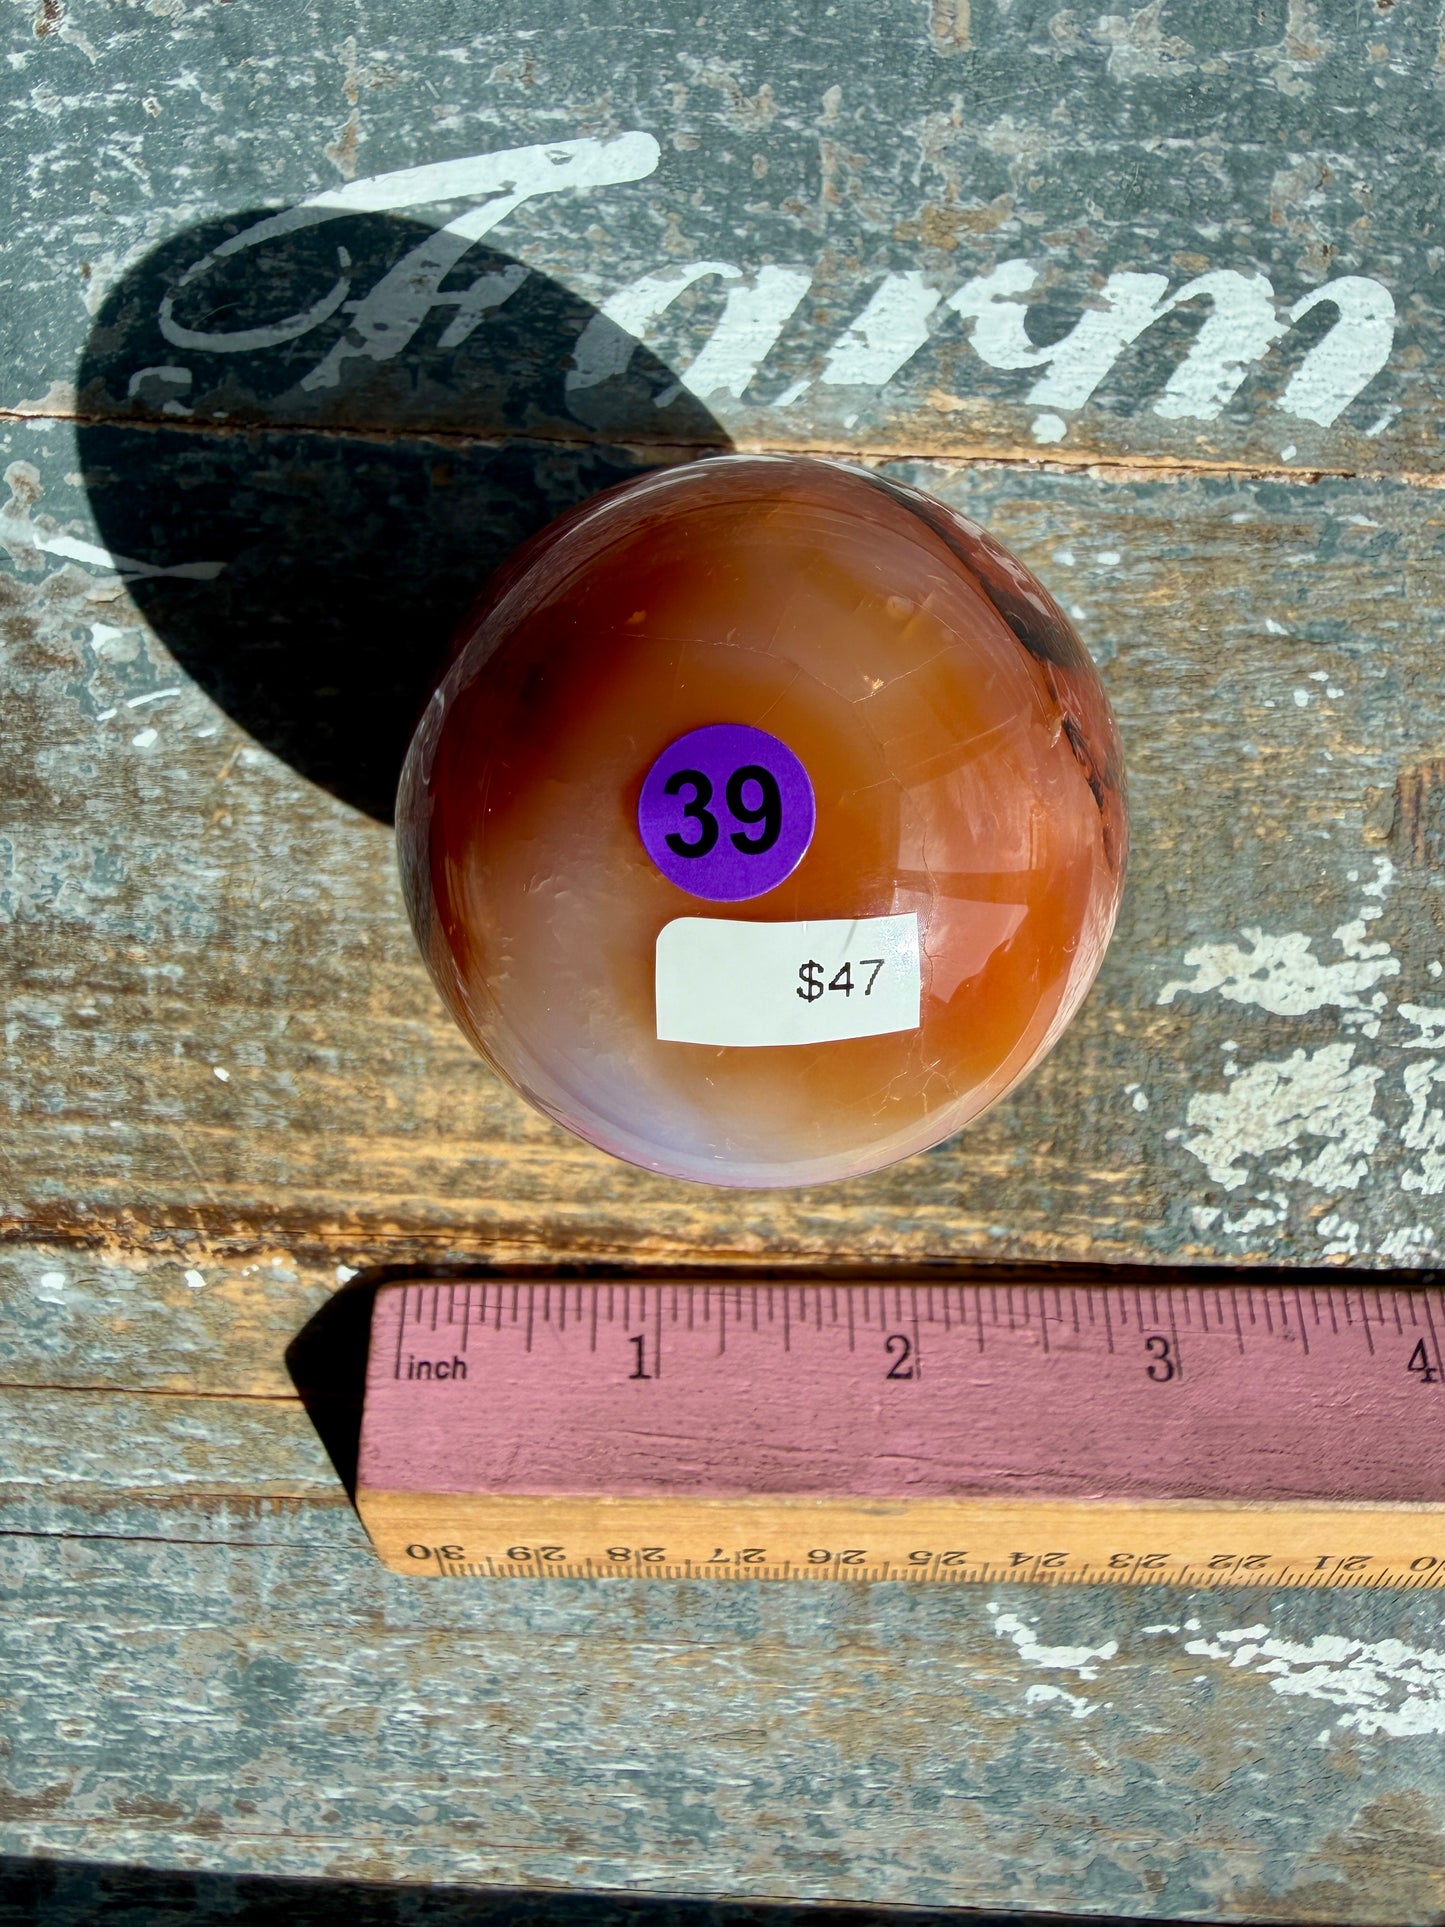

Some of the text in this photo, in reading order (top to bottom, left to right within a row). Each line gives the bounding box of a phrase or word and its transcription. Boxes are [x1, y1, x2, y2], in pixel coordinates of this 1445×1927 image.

[663, 764, 782, 859] 39
[796, 959, 885, 1003] $47
[407, 1334, 1436, 1383] inch 1 2 3 4
[405, 1544, 464, 1560] 30
[507, 1546, 566, 1562] 29
[606, 1546, 666, 1563] 28
[708, 1548, 766, 1564] 27
[807, 1549, 868, 1564] 26
[908, 1550, 969, 1566] 25
[1007, 1551, 1070, 1568] 24
[1108, 1552, 1173, 1569] 23
[1207, 1554, 1272, 1570] 22
[1315, 1555, 1373, 1571] 21
